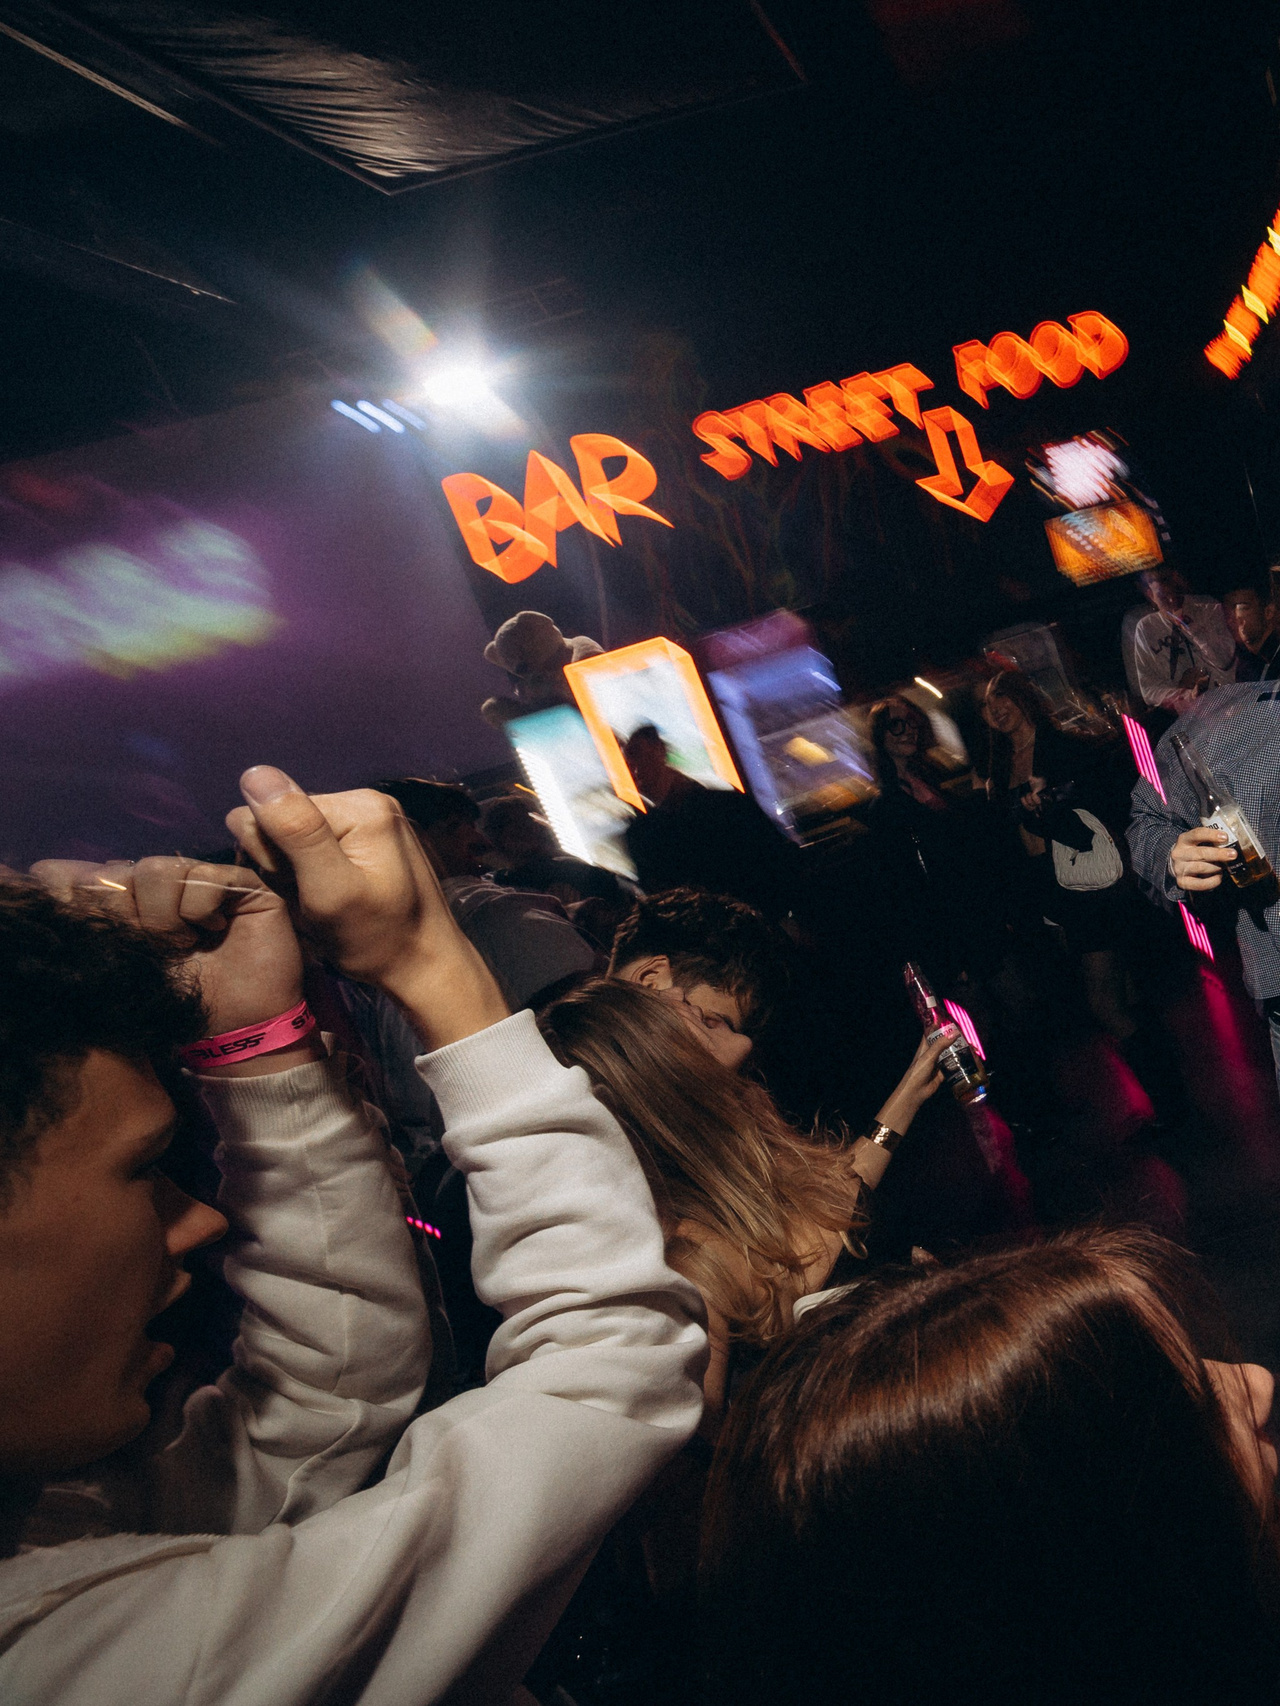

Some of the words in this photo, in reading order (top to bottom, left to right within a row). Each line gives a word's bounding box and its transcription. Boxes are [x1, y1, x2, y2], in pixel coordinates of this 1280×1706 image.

[692, 362, 934, 481] STREET
[952, 310, 1129, 409] FOOD
[441, 433, 674, 585] BAR
